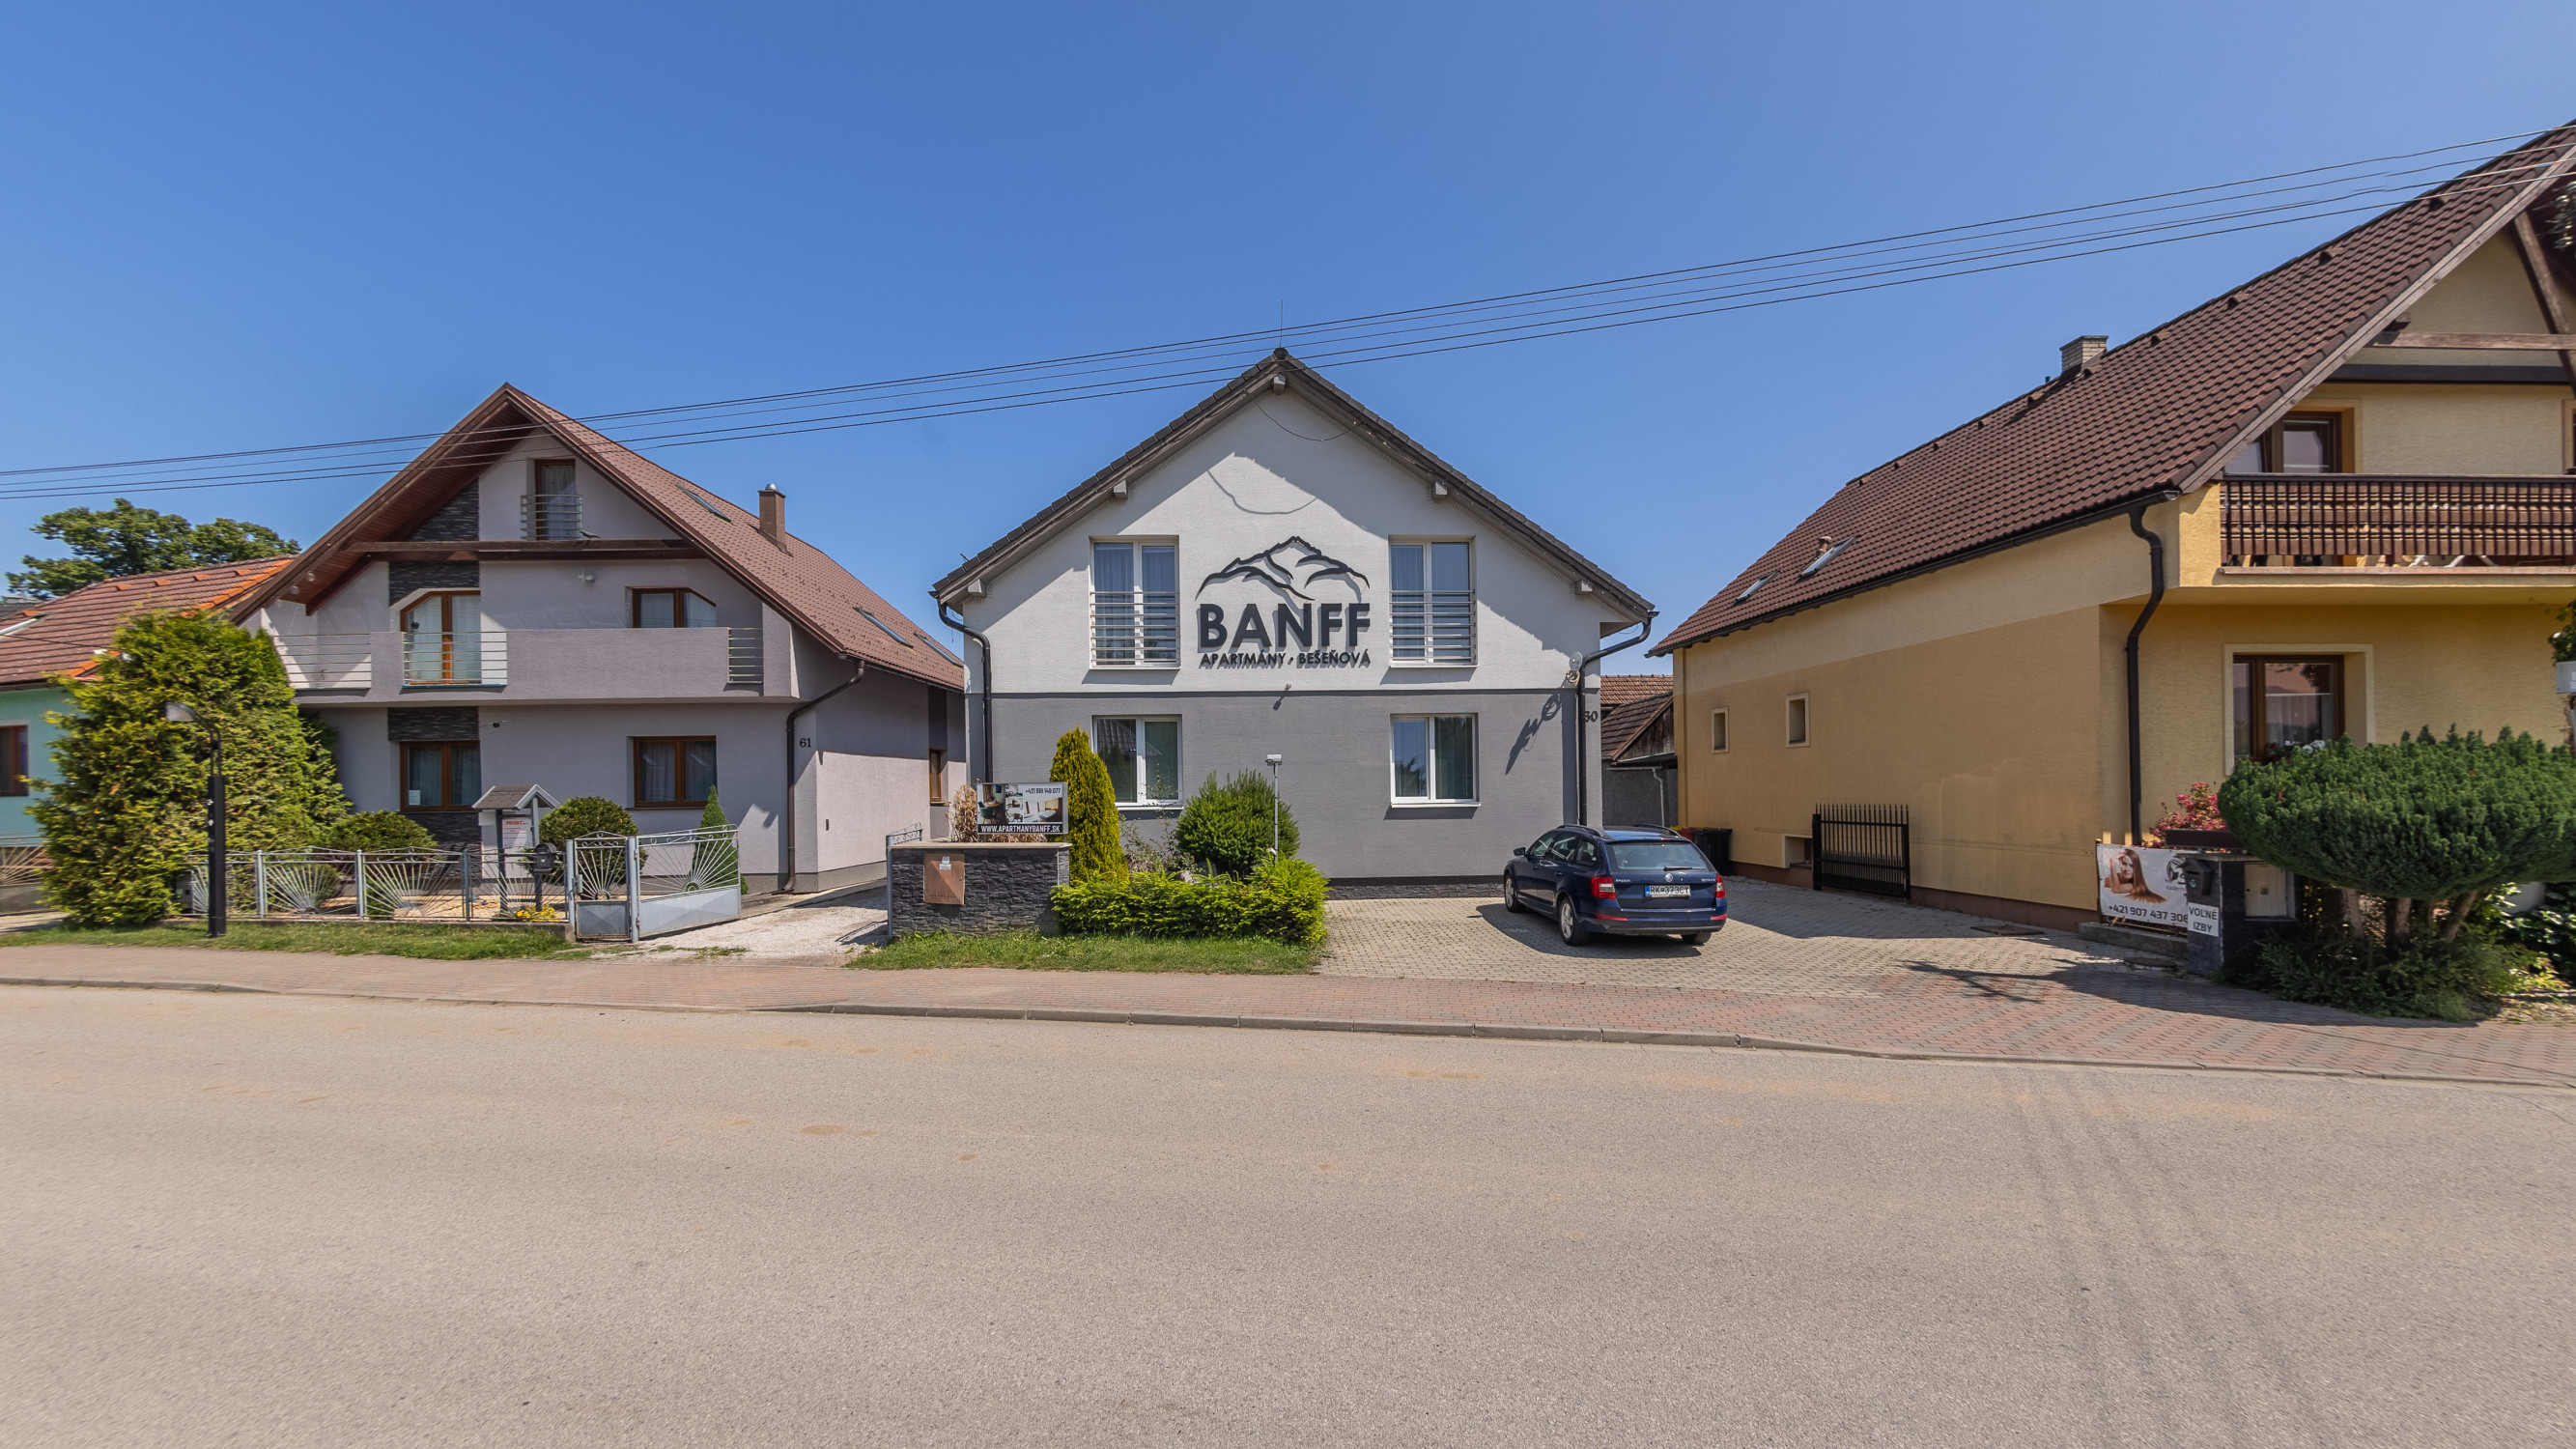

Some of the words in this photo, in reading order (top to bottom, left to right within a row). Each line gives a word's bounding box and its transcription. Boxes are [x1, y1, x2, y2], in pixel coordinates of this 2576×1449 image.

[1200, 603, 1370, 647] BANFF
[1201, 649, 1286, 665] APARTMÁNY
[1299, 648, 1371, 665] BEŠEŇOVÁ
[800, 737, 812, 748] 61
[2108, 904, 2128, 914] +421
[2130, 907, 2147, 917] 907
[2150, 910, 2167, 920] 437
[2193, 922, 2212, 932] IZBY
